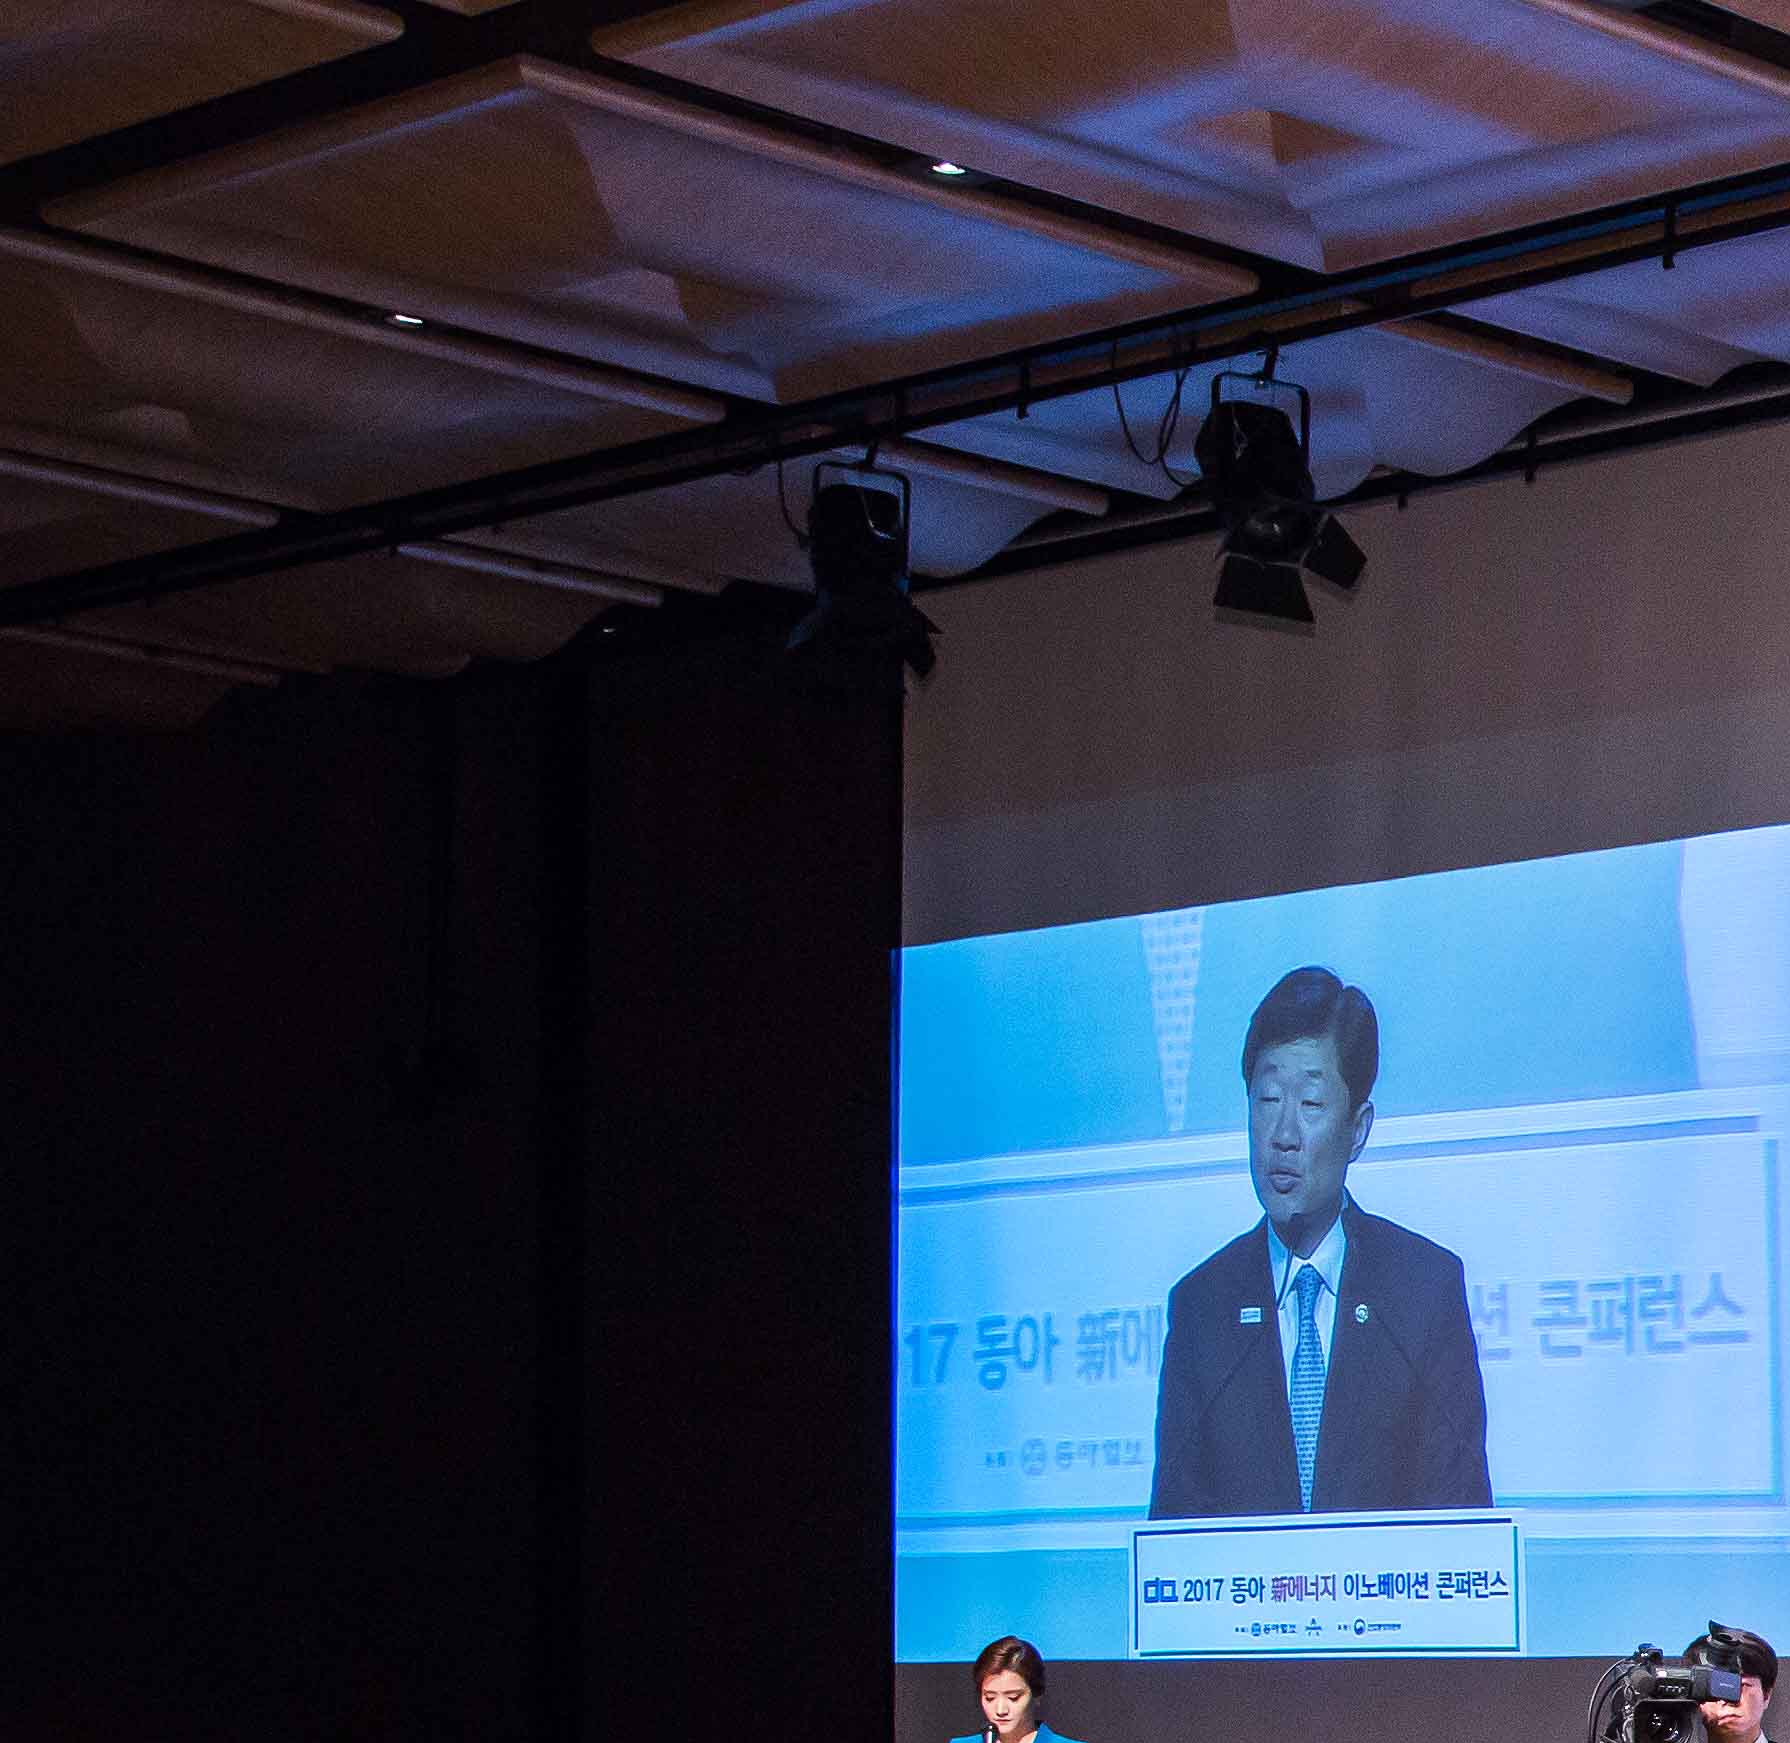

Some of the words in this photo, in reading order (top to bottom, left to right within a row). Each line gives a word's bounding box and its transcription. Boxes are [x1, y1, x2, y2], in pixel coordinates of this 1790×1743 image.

[973, 1312, 1060, 1391] 동아
[1531, 1272, 1751, 1358] 콘퍼런스
[1183, 1578, 1225, 1602] 2017
[1230, 1576, 1266, 1604] 동아
[1343, 1572, 1429, 1600] 이노베이션
[1435, 1570, 1510, 1600] 콘퍼런스
